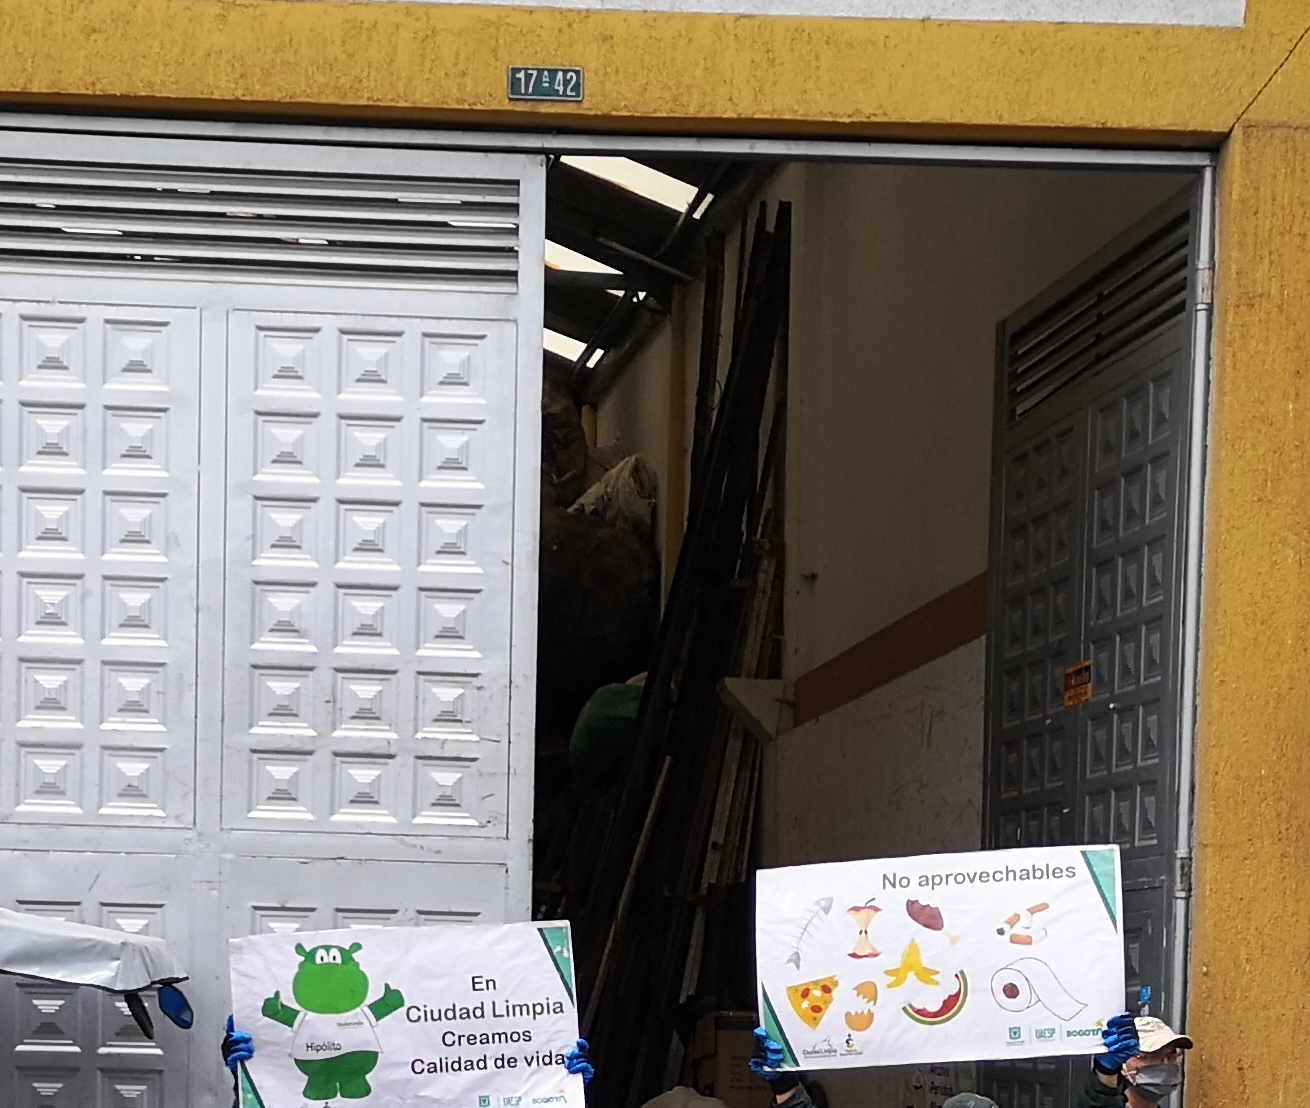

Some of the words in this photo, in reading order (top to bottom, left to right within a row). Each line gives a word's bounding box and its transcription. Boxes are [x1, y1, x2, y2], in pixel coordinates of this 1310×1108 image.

[515, 70, 537, 94] 17
[554, 70, 577, 95] 42
[882, 872, 911, 890] No
[918, 863, 1076, 891] aprovechables
[471, 976, 497, 991] En
[406, 1001, 485, 1023] Ciudad
[492, 997, 564, 1020] Limpia
[306, 1042, 342, 1053] Hipólito
[442, 1030, 532, 1047] Creamos
[411, 1054, 487, 1074] Calidad
[494, 1054, 518, 1069] de
[524, 1050, 565, 1067] vida
